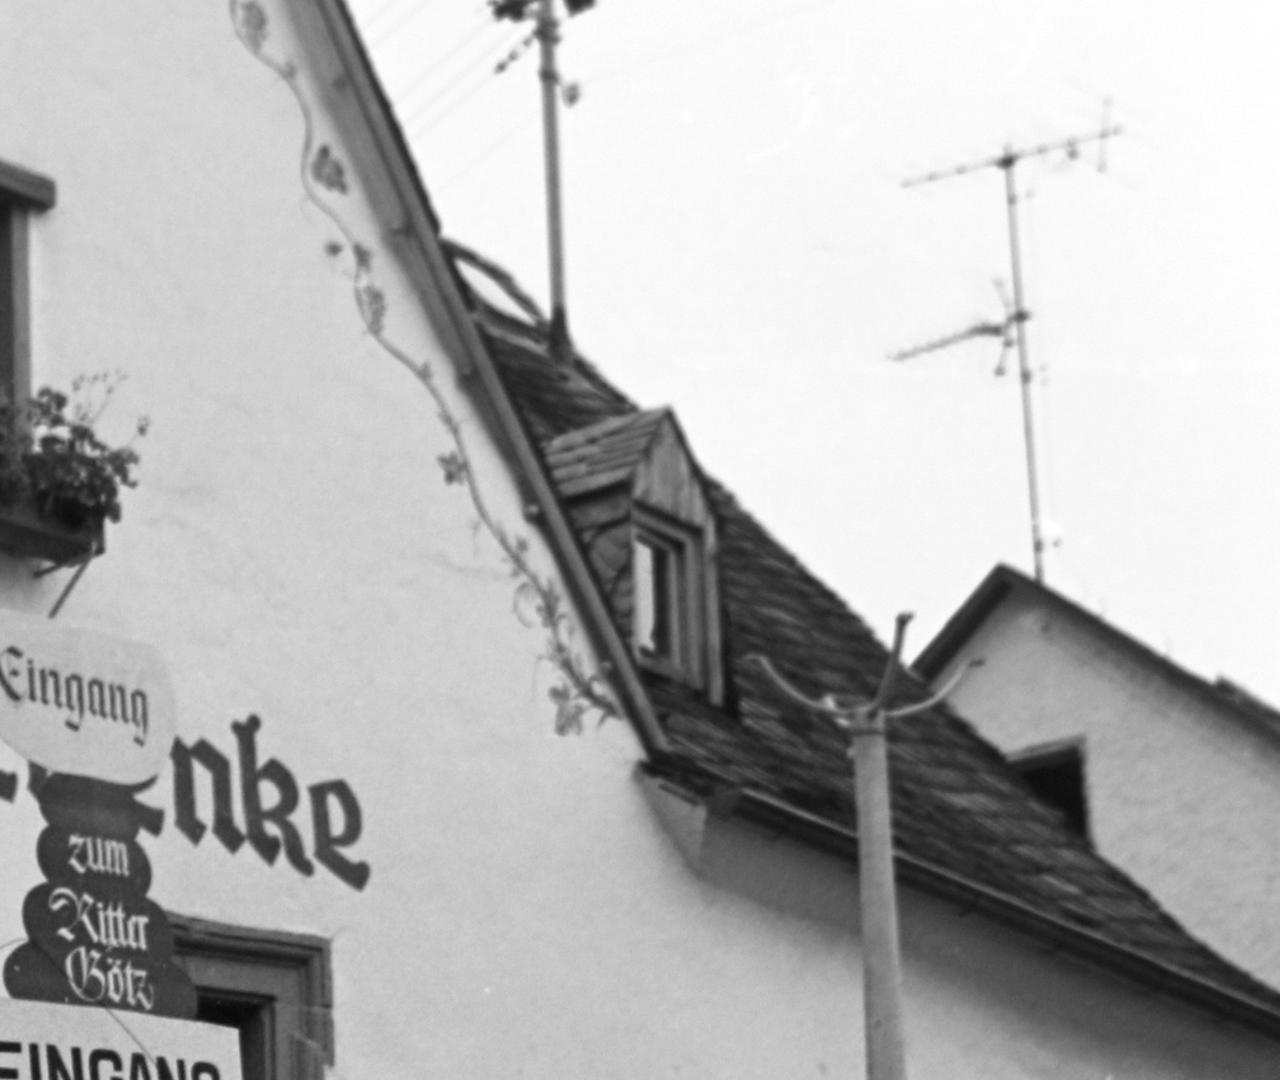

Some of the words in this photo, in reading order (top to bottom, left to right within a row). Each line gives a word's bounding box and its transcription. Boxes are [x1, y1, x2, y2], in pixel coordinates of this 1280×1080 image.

[67, 833, 130, 878] zum
[48, 887, 149, 952] Ritter
[65, 946, 155, 1009] Götz
